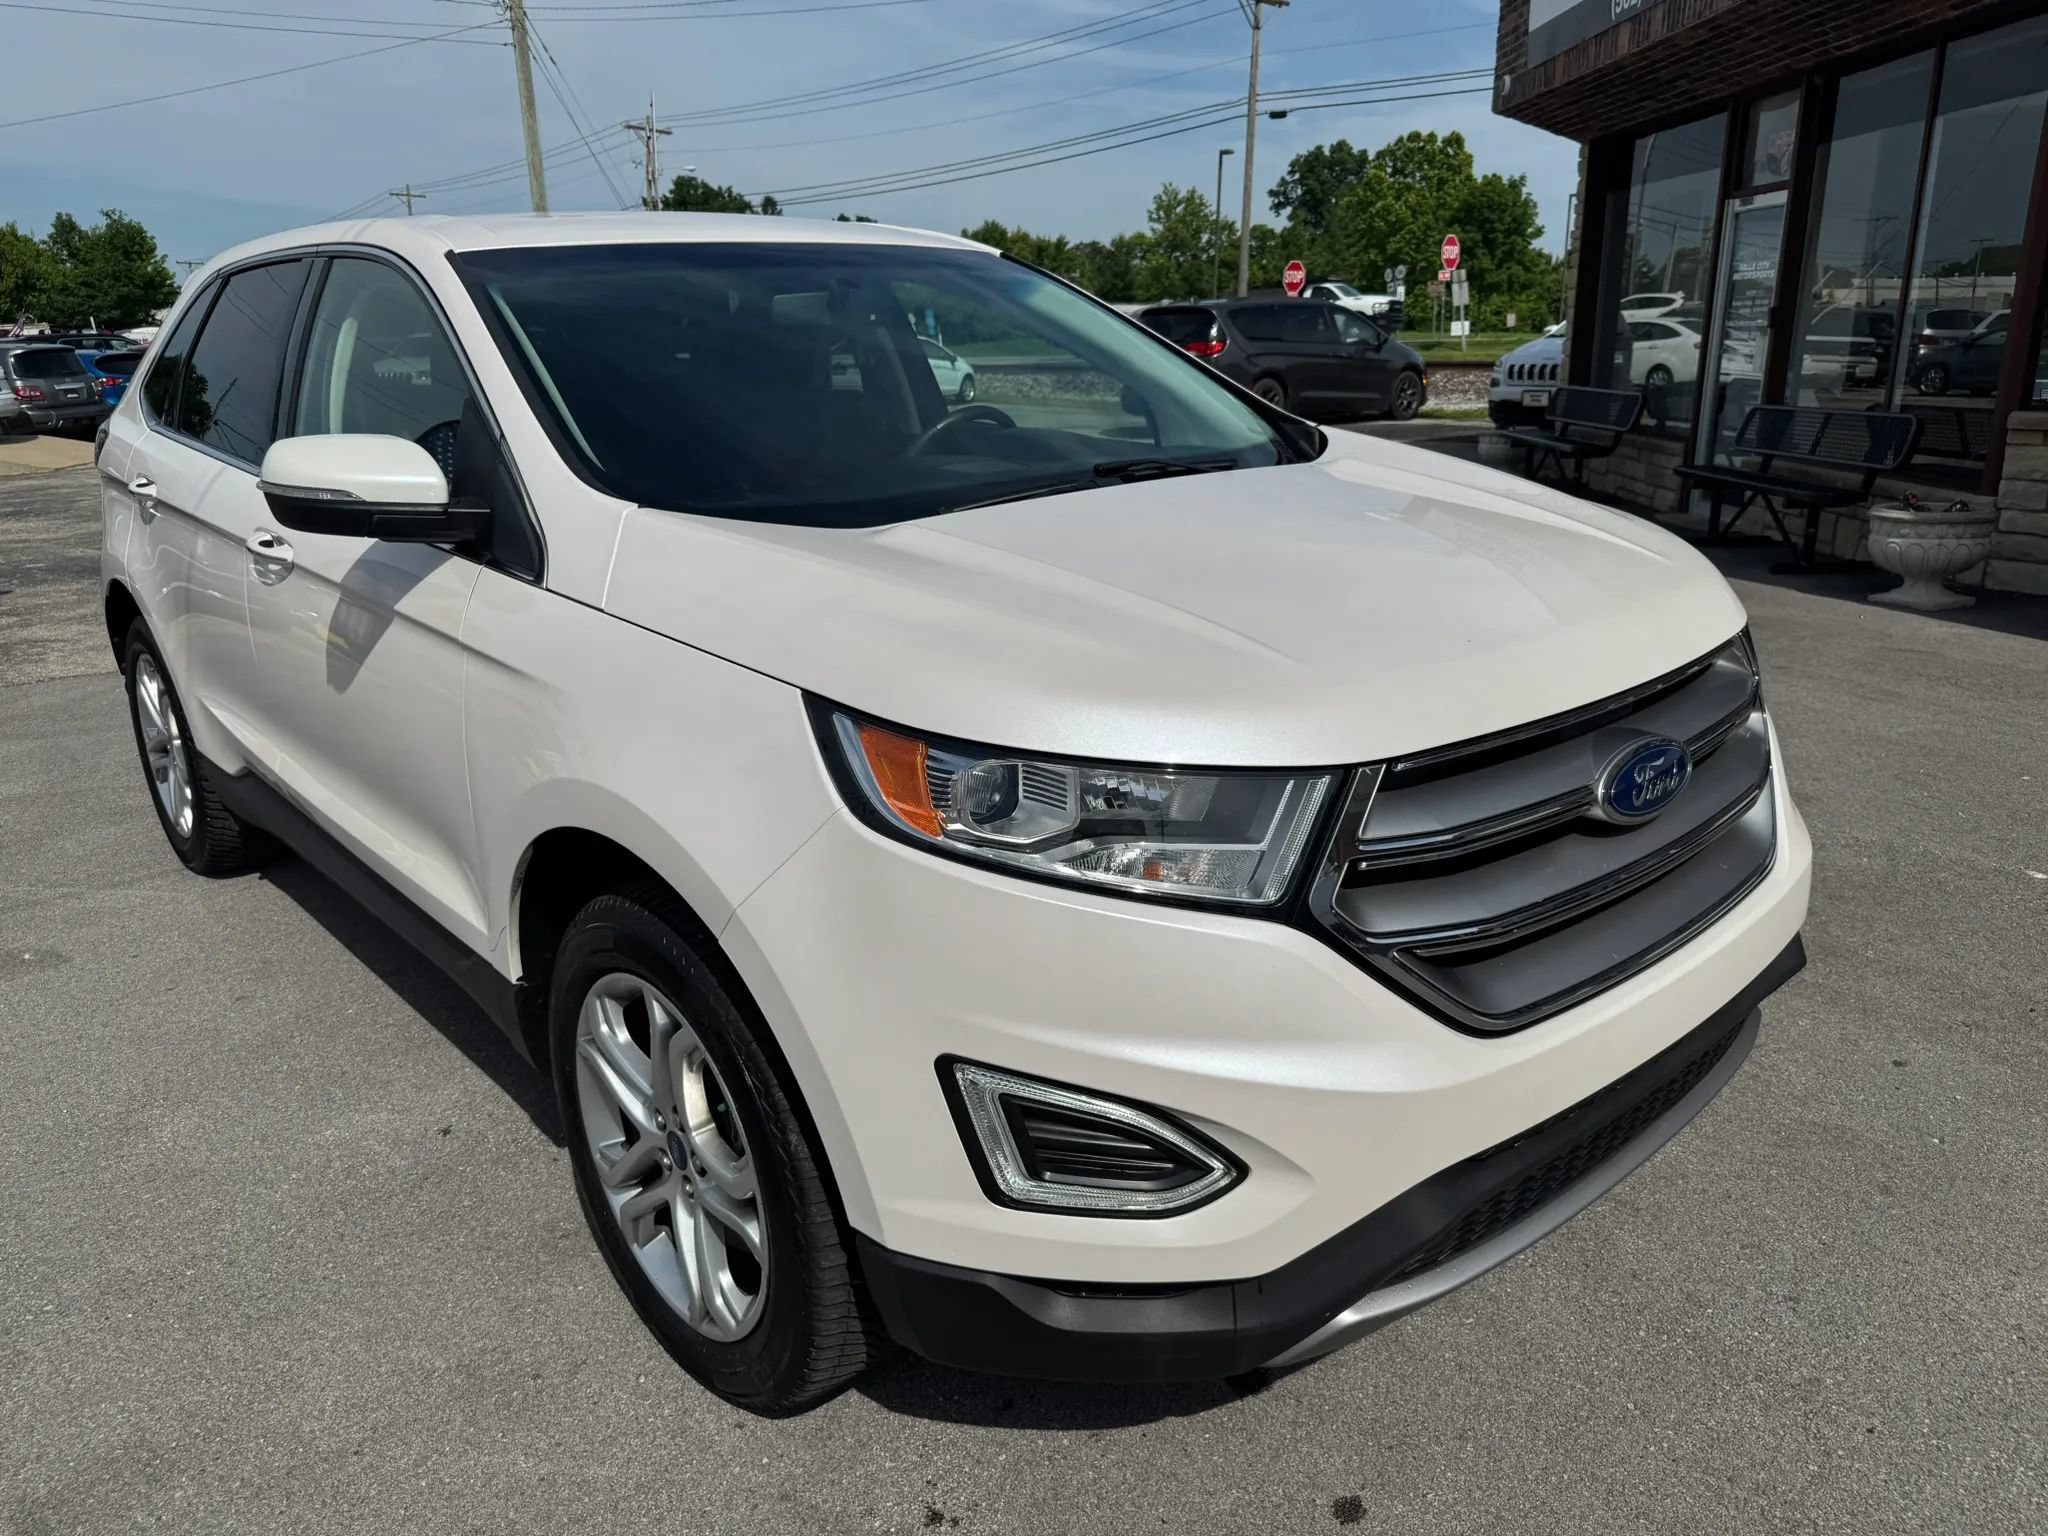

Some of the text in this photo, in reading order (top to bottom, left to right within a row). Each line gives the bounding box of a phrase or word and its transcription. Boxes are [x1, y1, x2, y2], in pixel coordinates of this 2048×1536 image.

[1443, 246, 1460, 259] STOP
[1284, 271, 1304, 283] STOP
[1632, 756, 1679, 807] Ford
